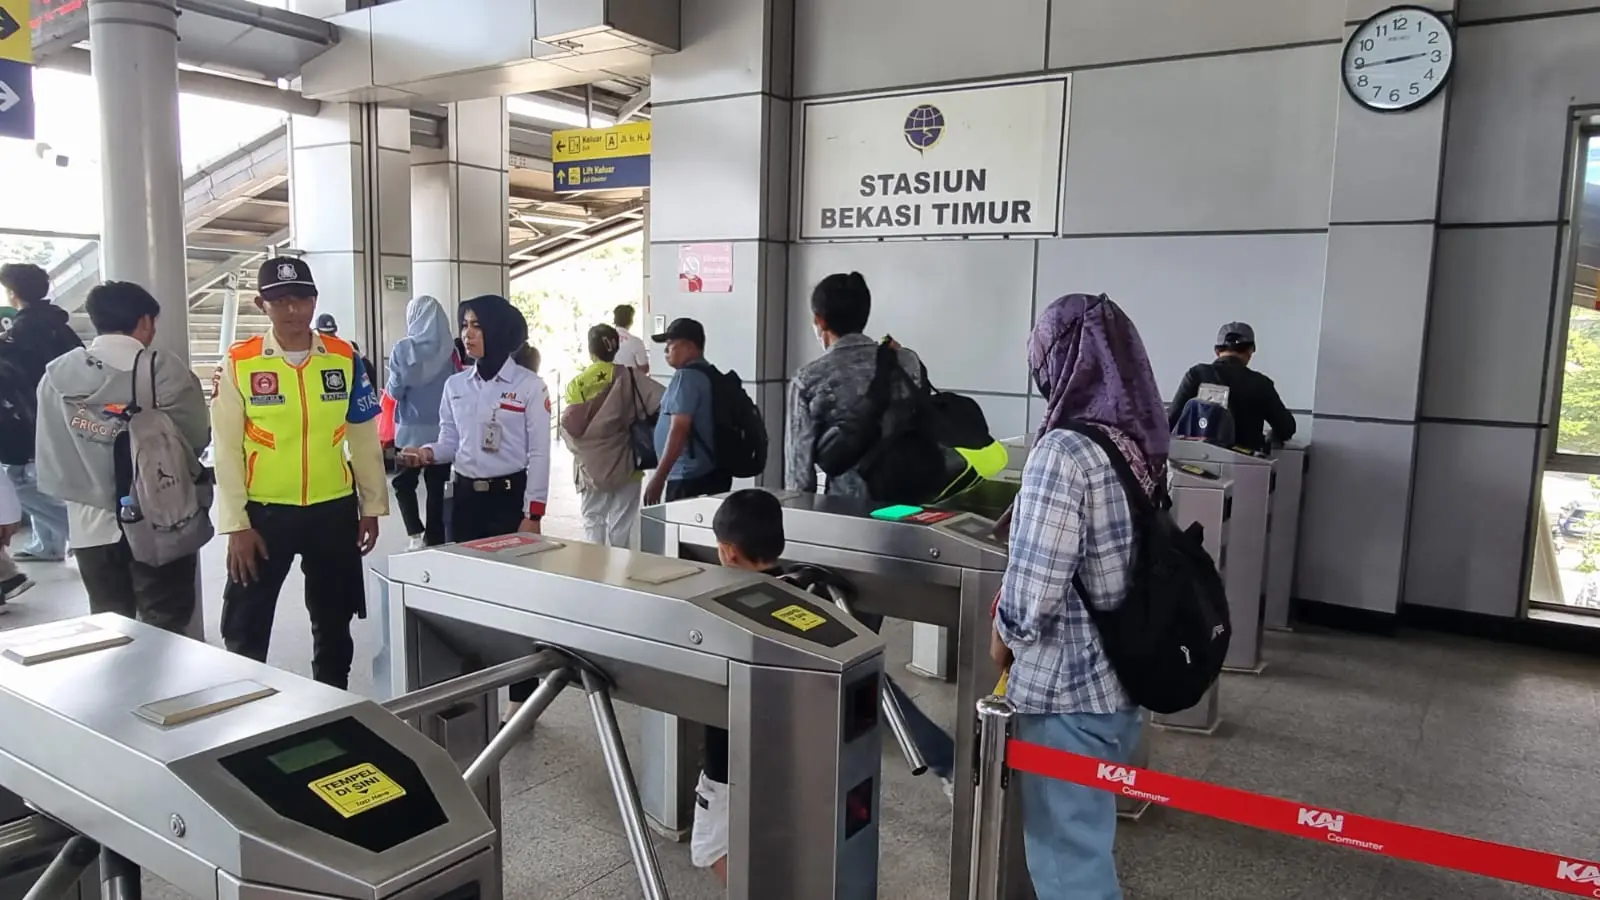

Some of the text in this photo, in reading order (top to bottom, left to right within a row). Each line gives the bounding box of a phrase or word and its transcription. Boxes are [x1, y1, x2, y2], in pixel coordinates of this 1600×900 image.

[1376, 25, 1387, 37] 11
[1393, 18, 1407, 31] 12
[1417, 22, 1421, 32] 1
[1428, 32, 1439, 44] 2
[1360, 39, 1374, 51] 10
[1354, 57, 1365, 69] 9
[1430, 50, 1441, 63] 3
[1357, 75, 1368, 87] 8
[1424, 69, 1433, 80] 4
[1372, 86, 1382, 98] 7
[1389, 89, 1400, 102] 6
[1409, 83, 1419, 95] 5
[608, 137, 615, 146] A
[859, 168, 986, 197] STASIUN
[820, 200, 1032, 229] BEKASI TIMUR
[71, 416, 107, 435] FRIGO
[321, 769, 377, 791] TEMPEL
[1097, 763, 1136, 786] KAI
[336, 777, 380, 796] DI SINI
[1122, 786, 1169, 803] Commuter
[1297, 808, 1344, 832] KAI
[1327, 832, 1384, 850] Commuter
